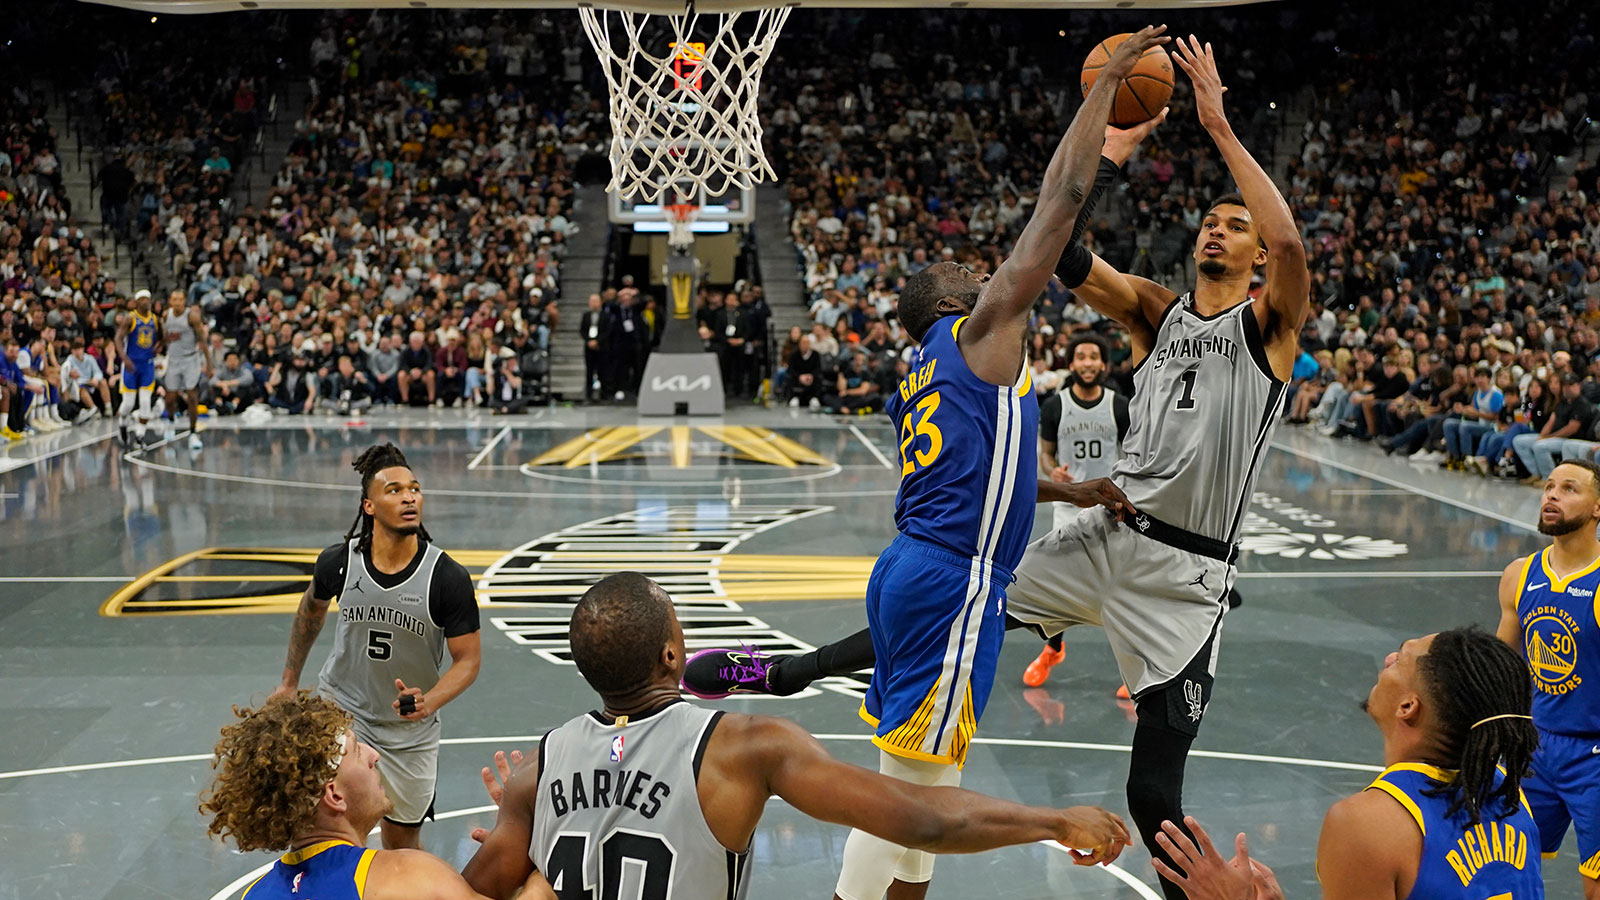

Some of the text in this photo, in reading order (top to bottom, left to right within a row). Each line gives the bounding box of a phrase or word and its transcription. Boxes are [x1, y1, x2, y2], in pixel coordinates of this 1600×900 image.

[1153, 338, 1180, 371] SN
[1175, 369, 1198, 411] 1
[900, 391, 943, 480] 23
[1073, 440, 1102, 459] 30
[1567, 586, 1593, 597] Rakuten
[342, 605, 425, 637] SAN ANTONIO
[1523, 606, 1581, 634] GOLDEN STATE
[367, 629, 393, 661] 5
[1550, 632, 1572, 655] 30
[550, 769, 671, 819] BARNES
[545, 826, 678, 900] 40
[1445, 821, 1527, 888] RICHARD
